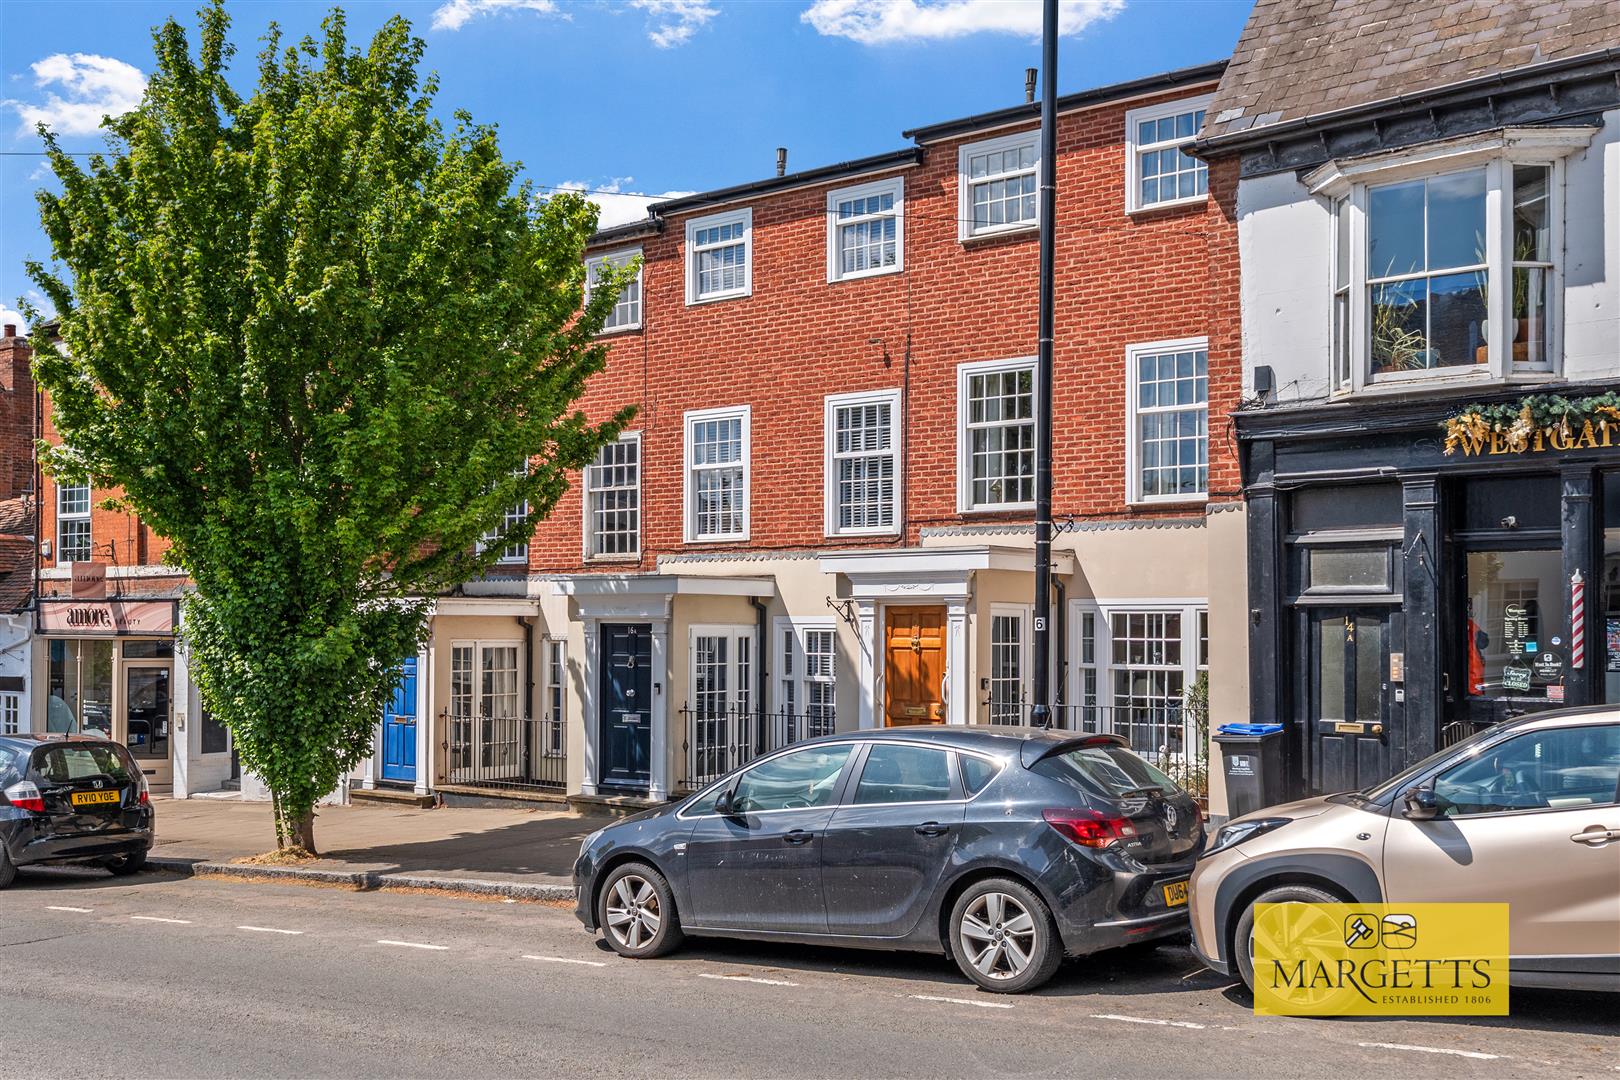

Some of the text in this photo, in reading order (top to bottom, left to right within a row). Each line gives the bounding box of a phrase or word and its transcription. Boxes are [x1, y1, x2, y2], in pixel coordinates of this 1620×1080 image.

[1459, 421, 1620, 457] WESTGAT
[1036, 619, 1043, 629] 6
[77, 792, 114, 803] RV10 YOE
